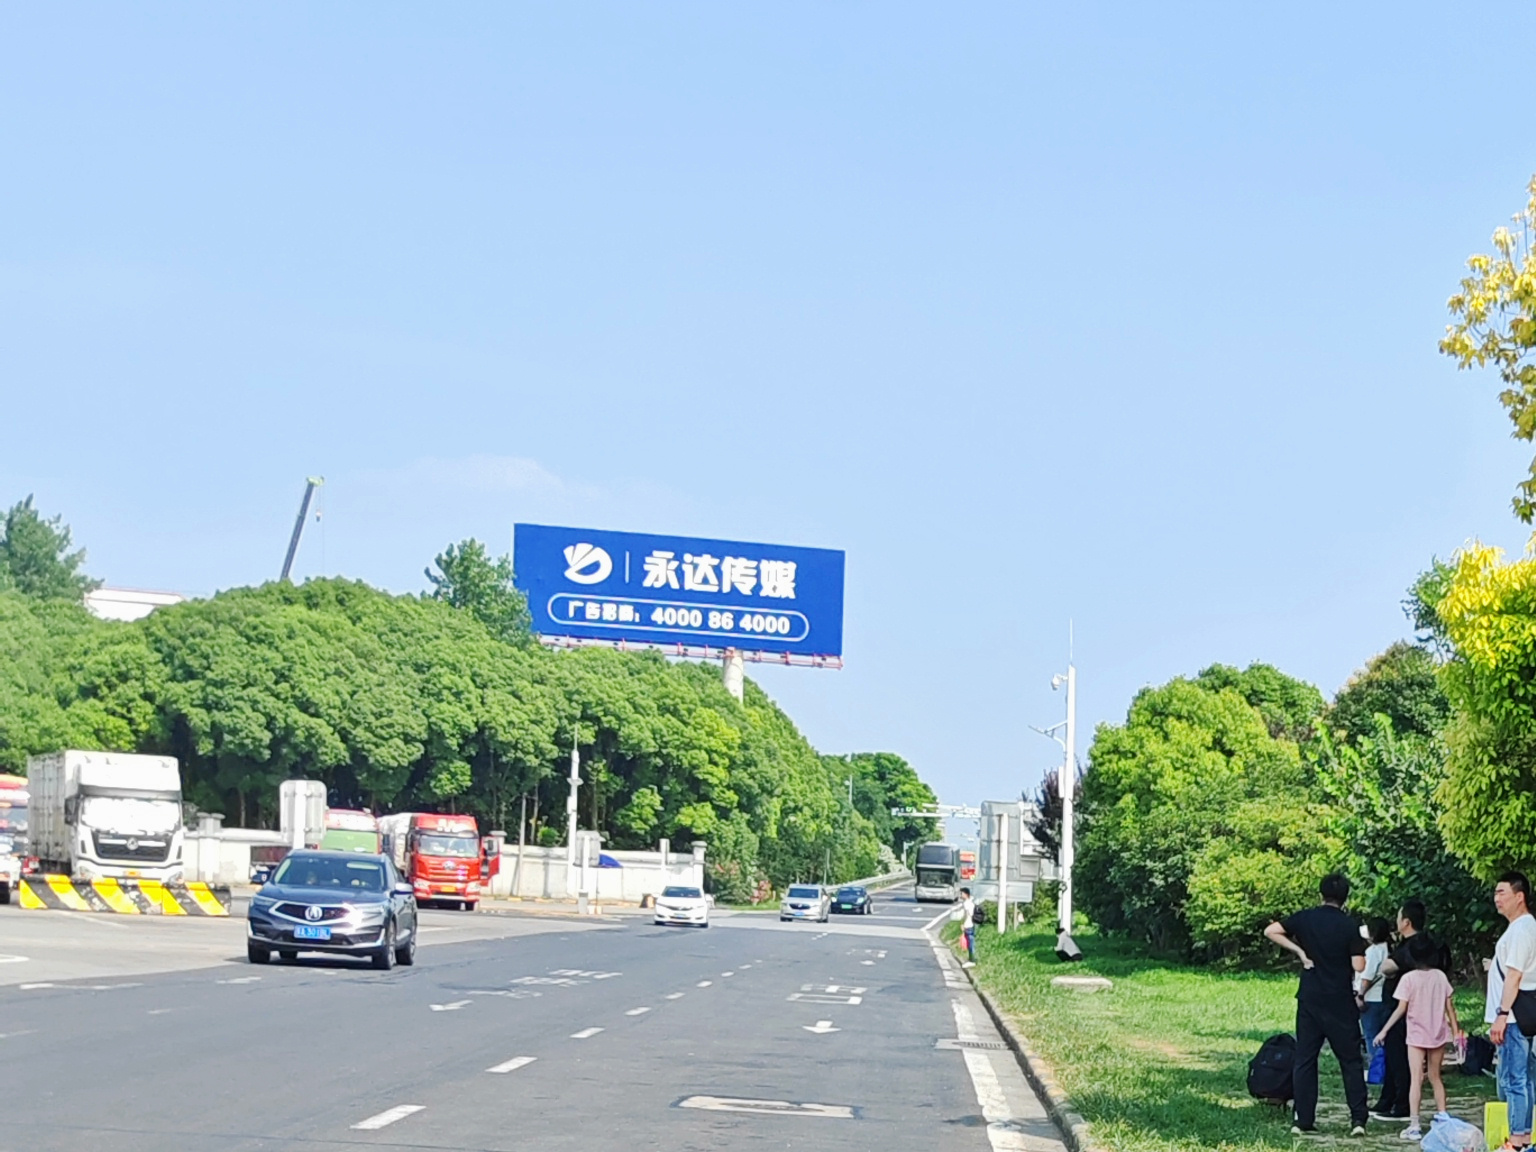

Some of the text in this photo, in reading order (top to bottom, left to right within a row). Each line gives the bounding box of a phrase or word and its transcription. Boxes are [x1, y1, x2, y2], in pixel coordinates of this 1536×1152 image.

[643, 551, 797, 599] 永达传媒
[651, 606, 702, 627] 4000
[708, 611, 734, 630] 86
[739, 614, 790, 634] 4000
